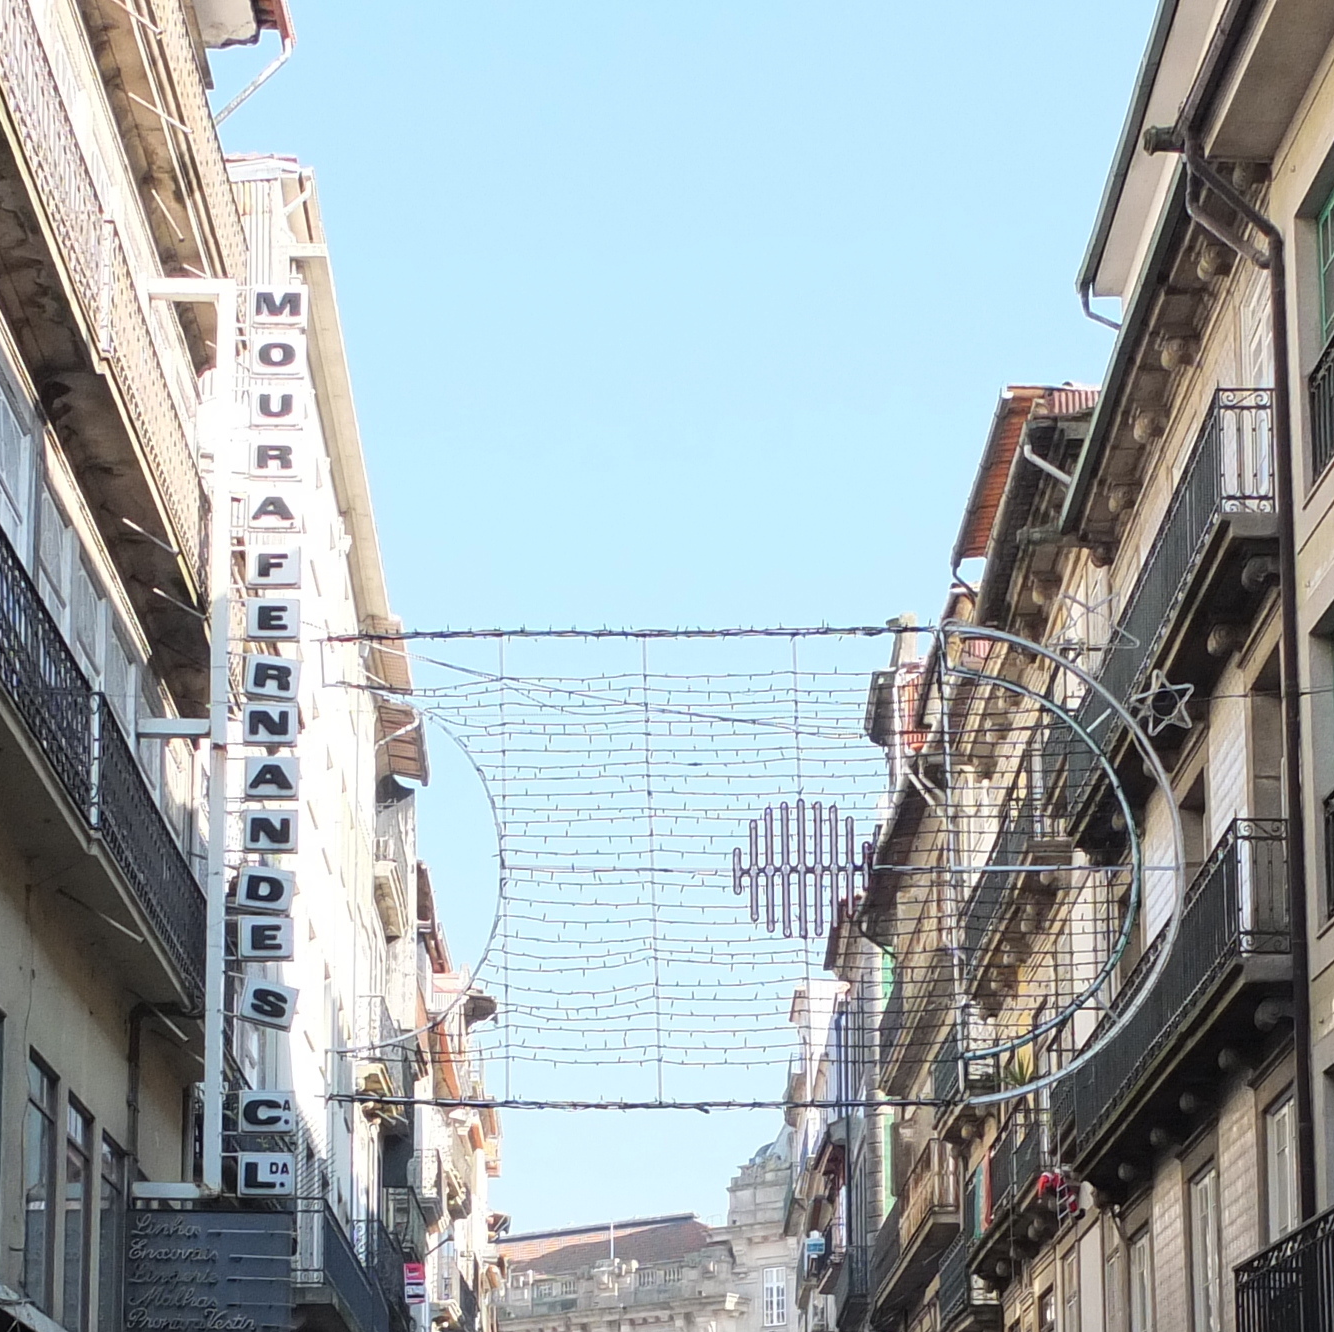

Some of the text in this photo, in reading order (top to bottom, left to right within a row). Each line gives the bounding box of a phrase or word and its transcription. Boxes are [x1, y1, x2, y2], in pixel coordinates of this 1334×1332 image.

[252, 292, 302, 520] MOURA
[245, 552, 293, 1020] FERNANDES
[130, 1213, 201, 1236] Linhos
[129, 1239, 219, 1260] Enxovais
[128, 1286, 218, 1307] Malhas
